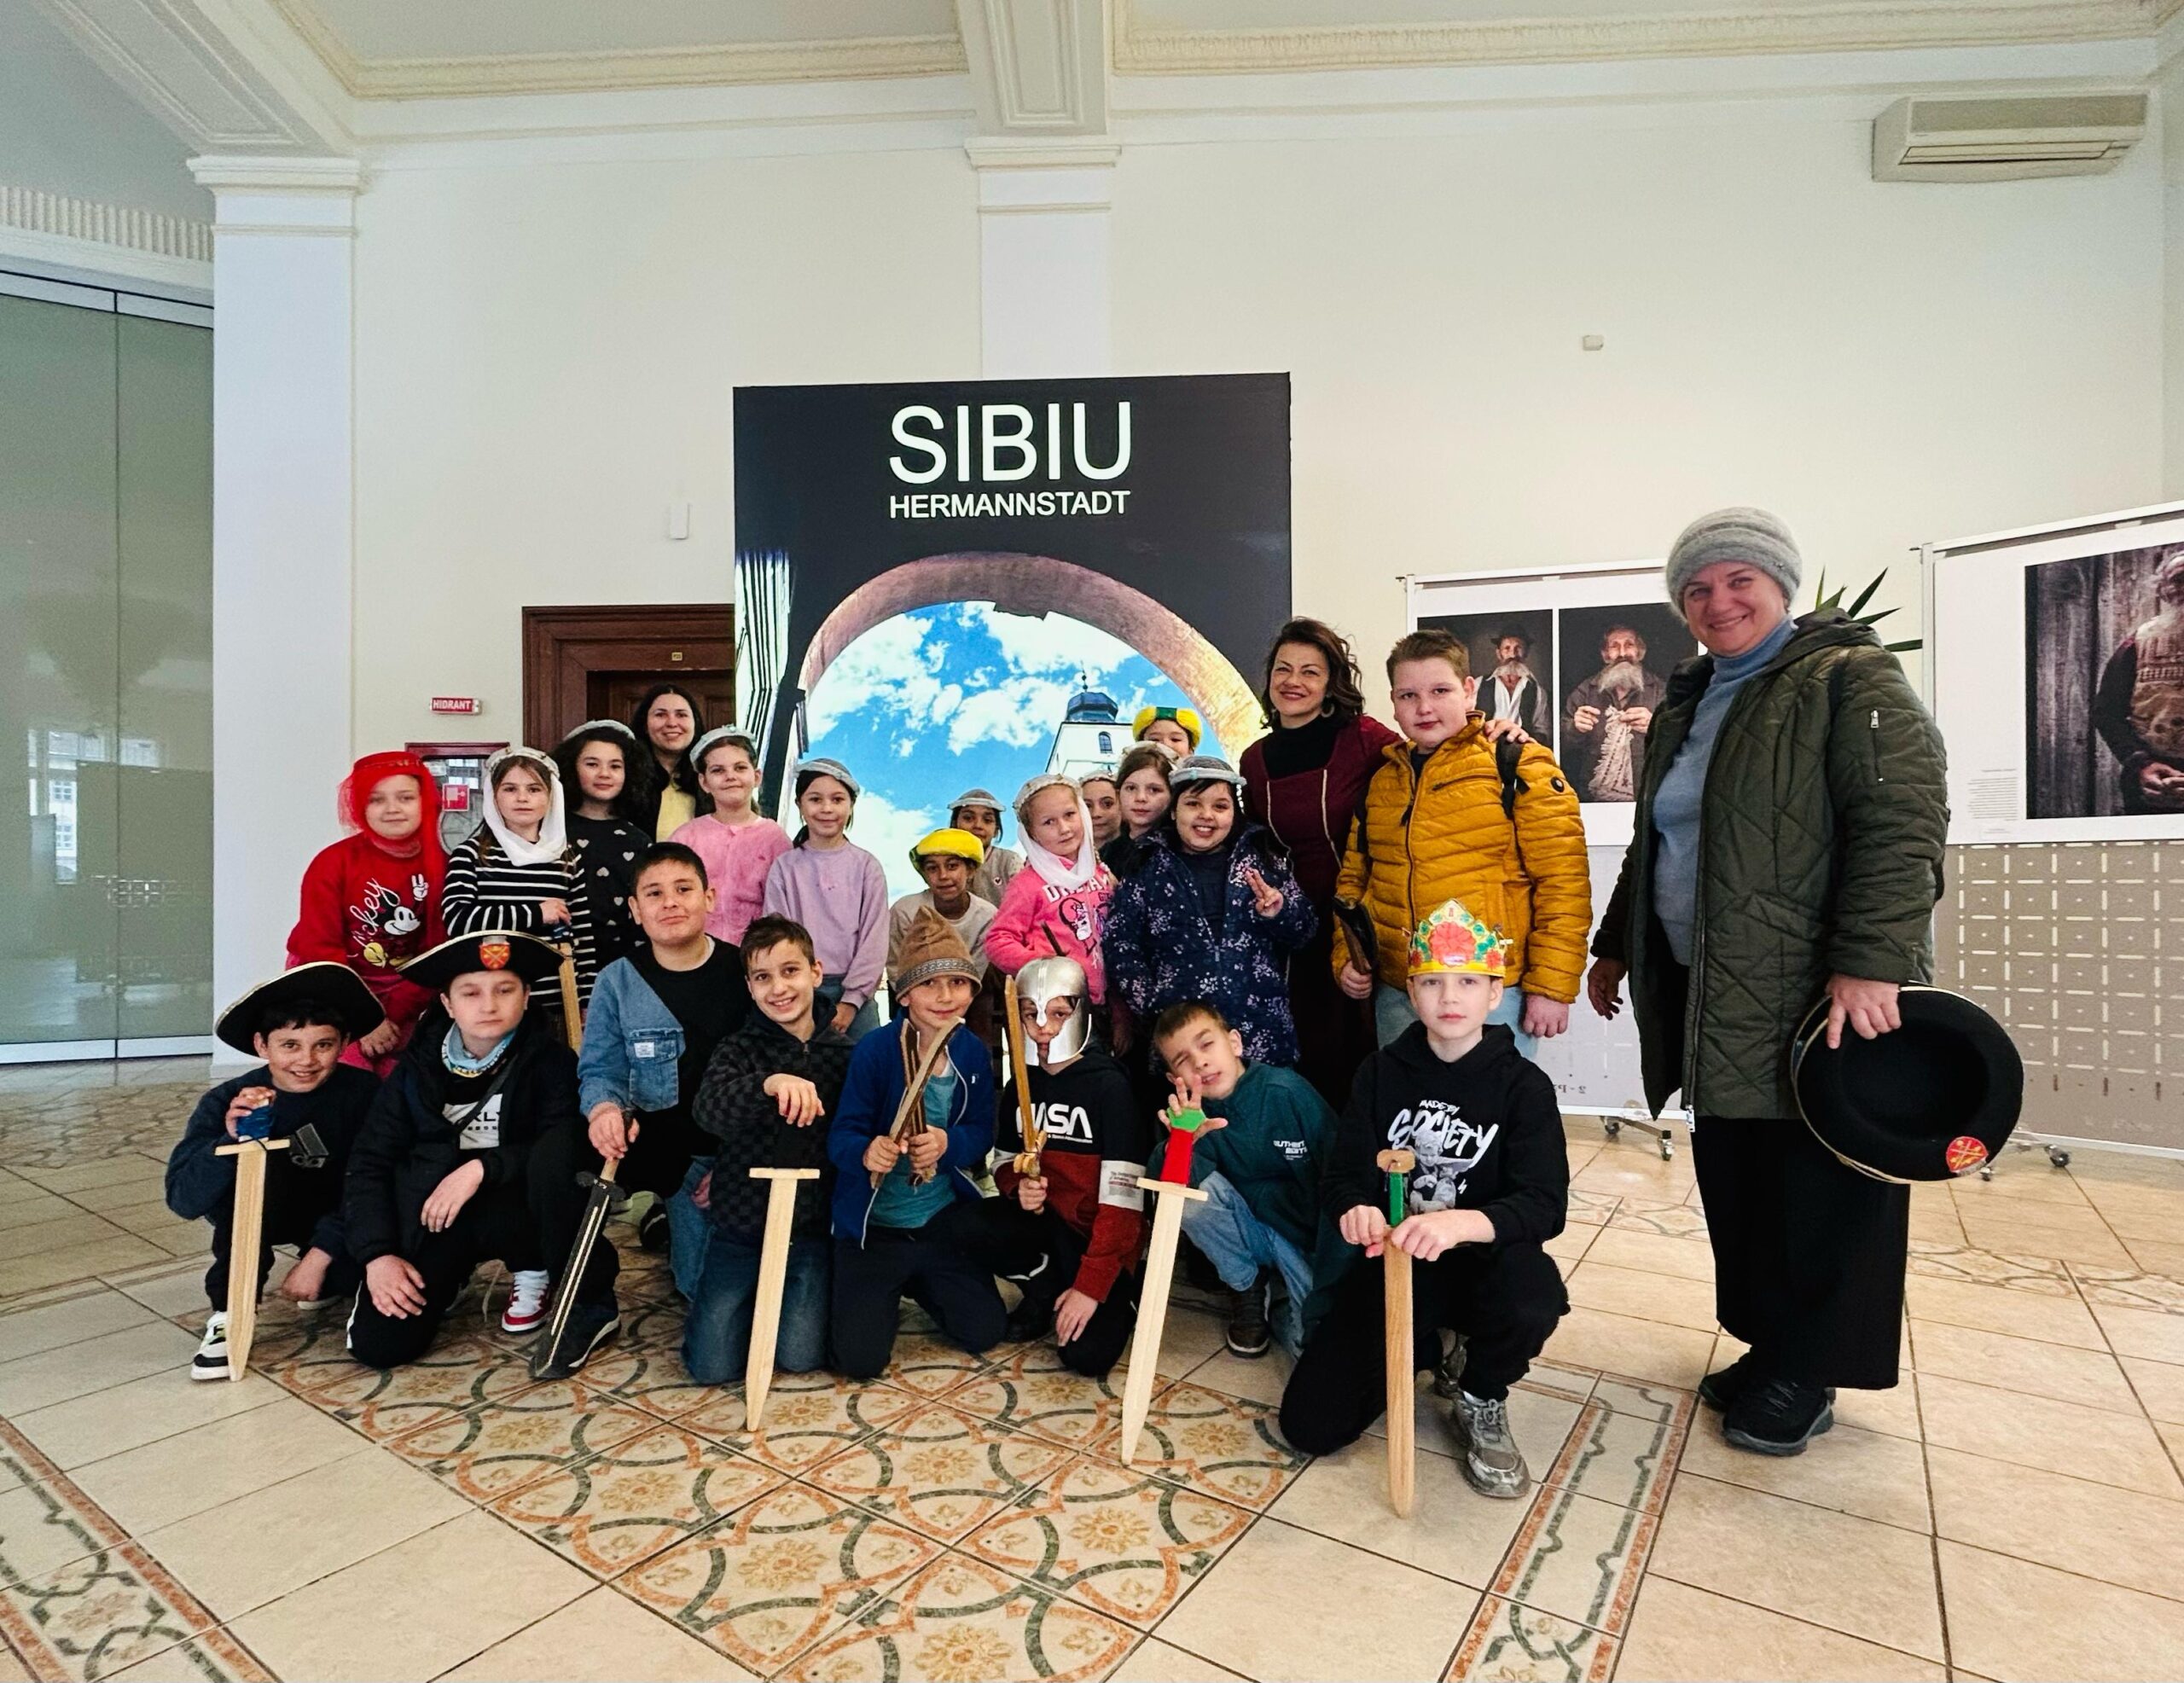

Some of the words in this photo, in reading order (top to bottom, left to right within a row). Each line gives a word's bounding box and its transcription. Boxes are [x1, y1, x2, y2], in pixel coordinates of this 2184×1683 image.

[889, 401, 1132, 485] SIBIU
[889, 490, 1131, 519] HERMANNSTADT
[433, 699, 472, 710] HIDRANT
[1015, 1101, 1093, 1139] NASA
[1419, 1100, 1448, 1111] MADE
[1444, 1104, 1461, 1116] BY
[1387, 1108, 1500, 1169] SOCIETY
